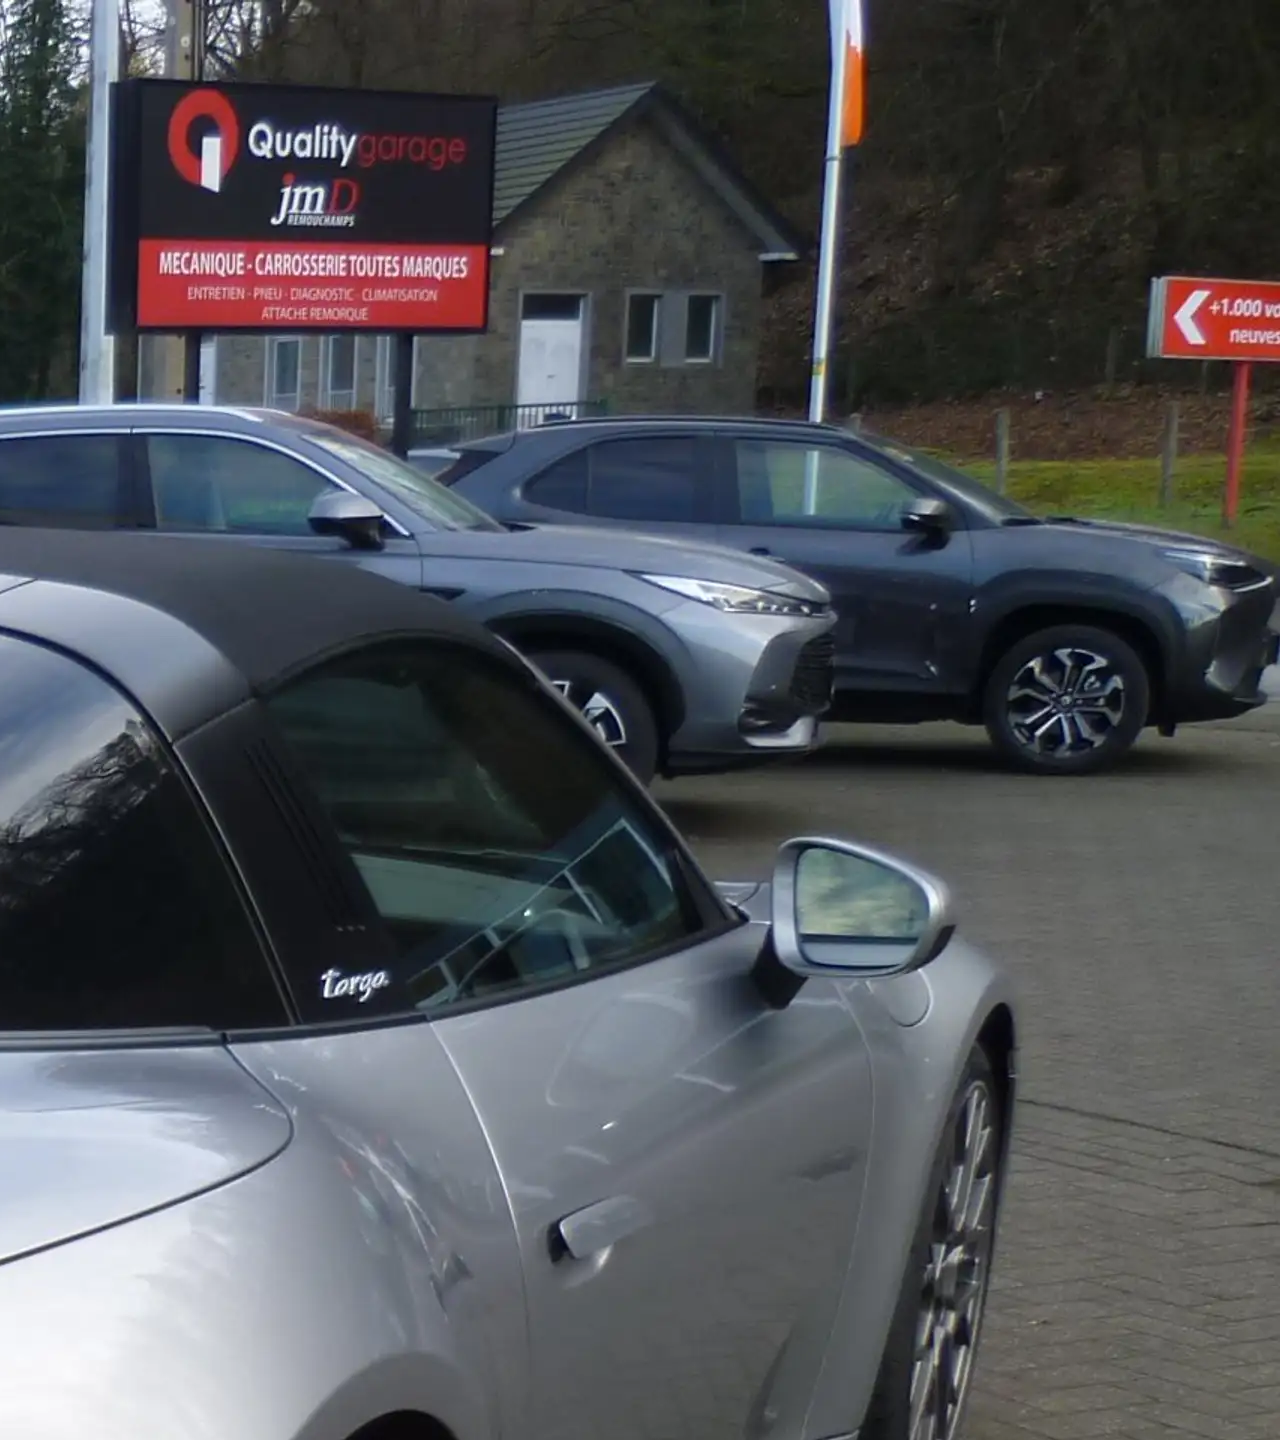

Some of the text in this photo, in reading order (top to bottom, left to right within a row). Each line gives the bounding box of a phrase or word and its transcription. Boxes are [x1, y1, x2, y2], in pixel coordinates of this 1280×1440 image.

[287, 213, 356, 228] REMOUCHAMPS
[159, 252, 245, 277] MECANIQUE
[255, 253, 347, 276] CARROSSERIE
[348, 254, 399, 277] TOUTES
[402, 255, 468, 281] MARQUES
[187, 285, 245, 301] ENTRETIEN
[253, 286, 282, 301] PNEU
[290, 286, 354, 301] DIAGNOSTIC
[361, 287, 438, 302] CLIMATISATION
[261, 306, 369, 322] ATTACHE REMORQUE
[1208, 298, 1262, 317] +1.000
